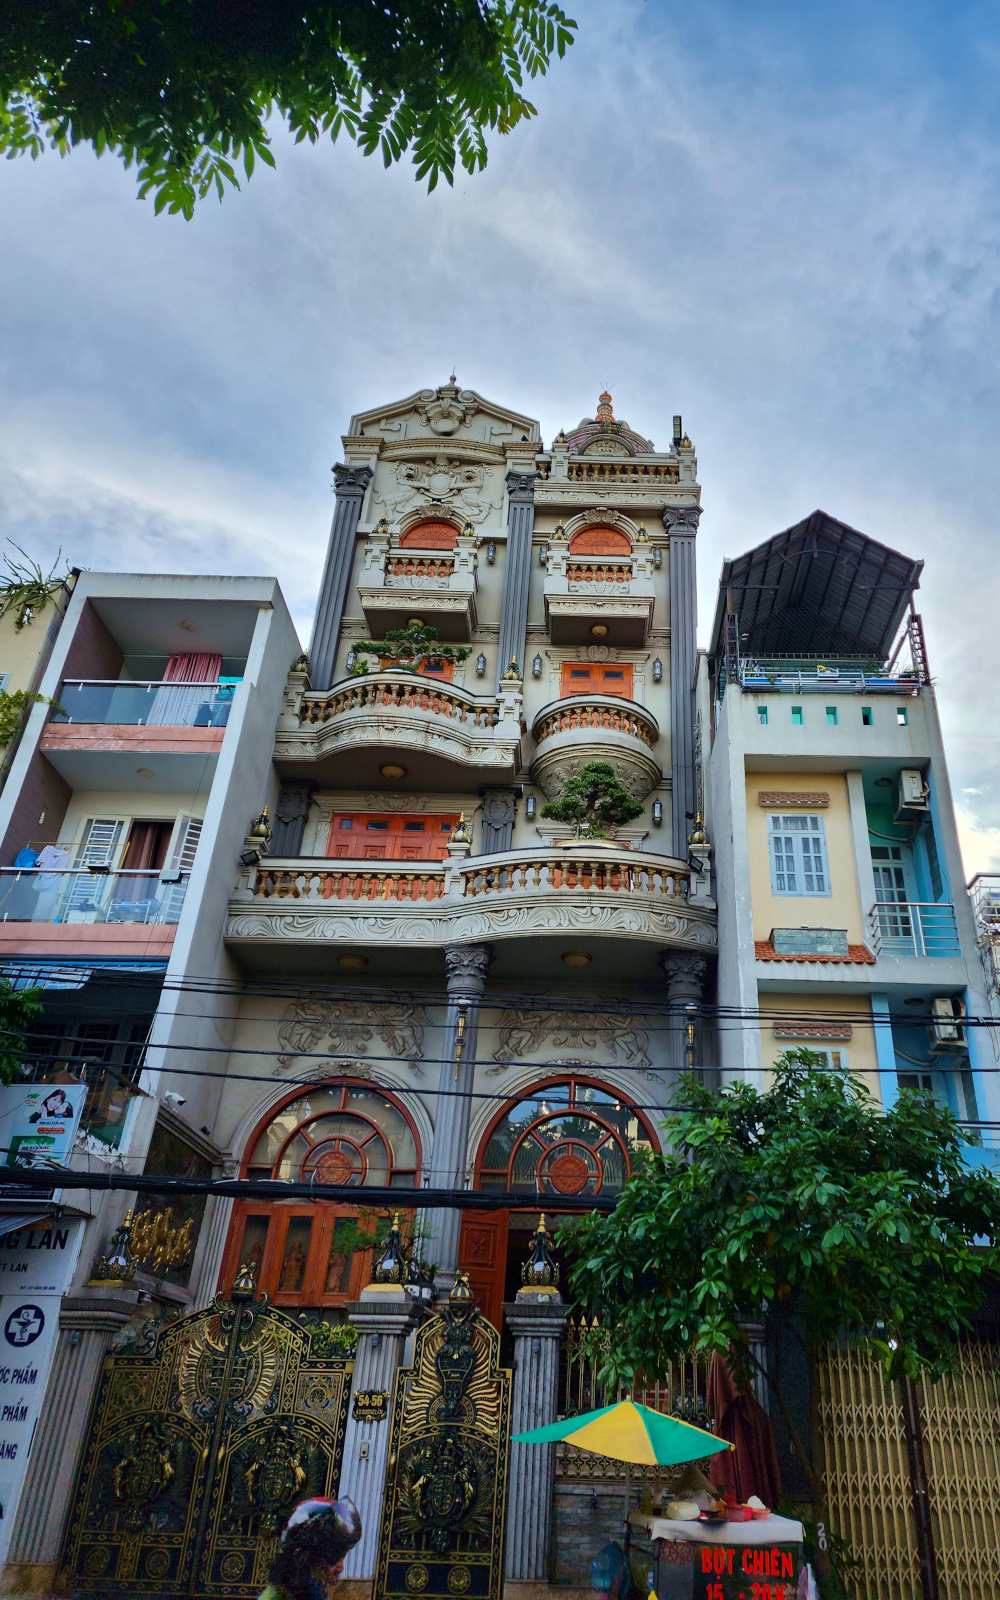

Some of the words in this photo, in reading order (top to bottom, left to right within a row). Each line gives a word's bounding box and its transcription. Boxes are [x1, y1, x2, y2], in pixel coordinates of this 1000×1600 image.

[26, 1229, 69, 1250] LAN
[10, 1262, 28, 1273] LAN
[11, 1361, 38, 1385] PHẨM
[1, 1397, 28, 1422] PHẨM
[701, 1546, 735, 1580] BỘT
[742, 1546, 793, 1578] CHIÊN
